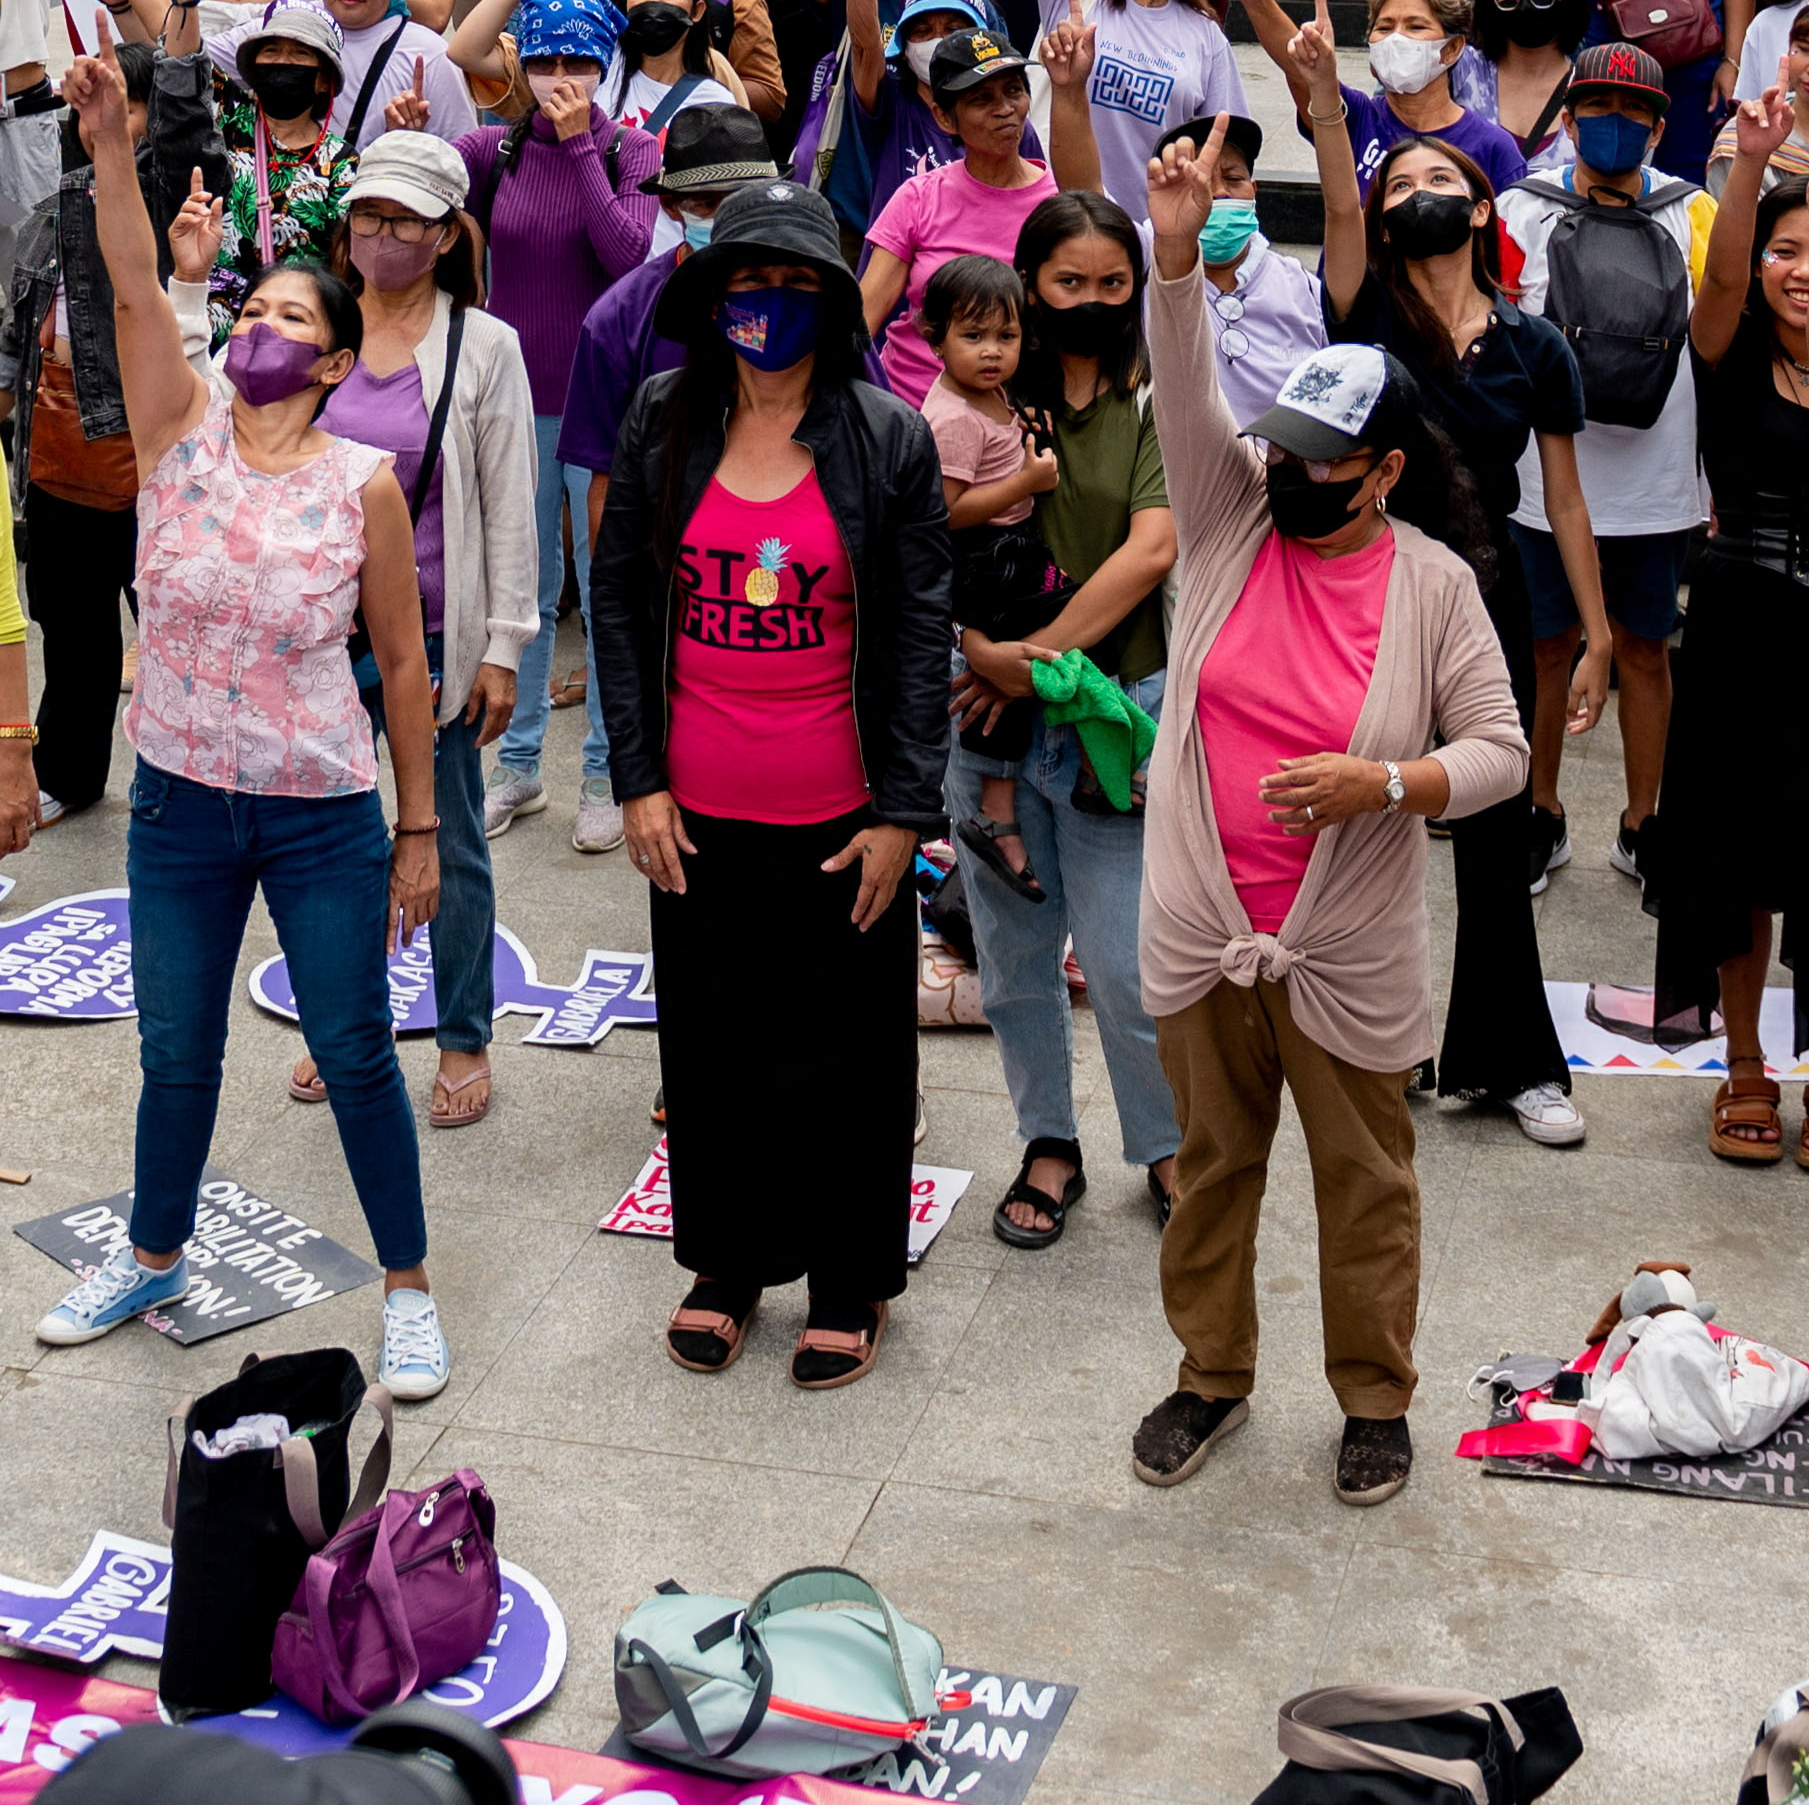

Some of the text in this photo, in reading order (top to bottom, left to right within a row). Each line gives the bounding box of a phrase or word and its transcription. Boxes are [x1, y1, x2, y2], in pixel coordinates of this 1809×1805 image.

[1099, 40, 1123, 55] NEW
[1608, 51, 1636, 79] NY
[680, 536, 830, 607] STY
[684, 600, 822, 650] FRESH
[551, 964, 635, 1042] GABRIELA
[200, 1180, 323, 1250] ONSITE
[192, 1203, 336, 1309] ABILITATION
